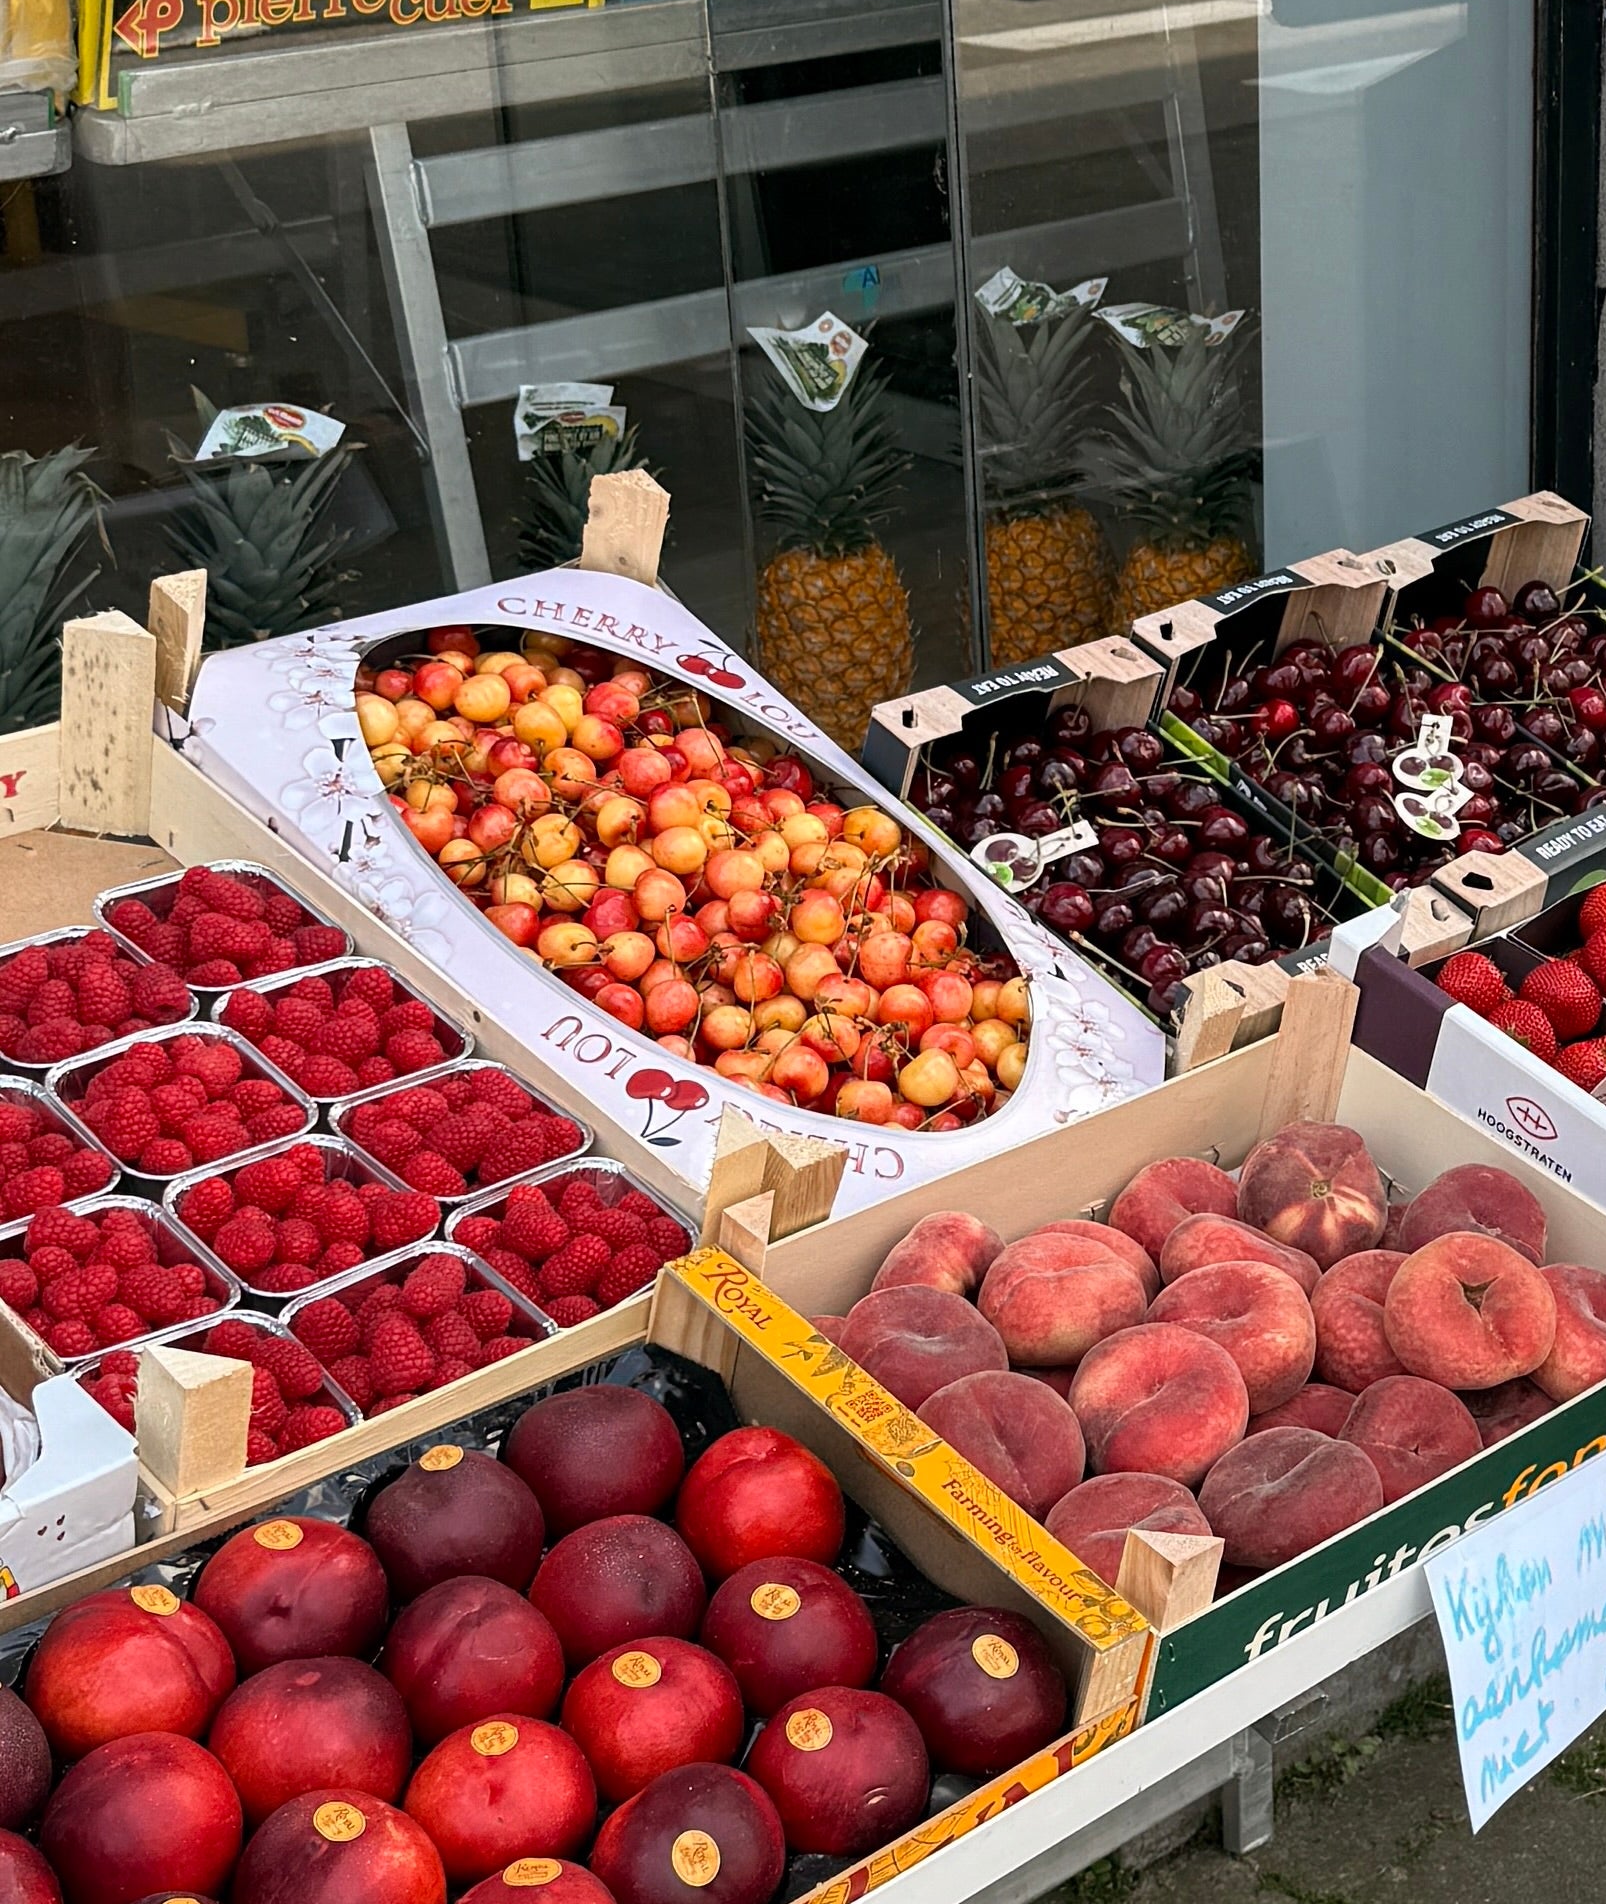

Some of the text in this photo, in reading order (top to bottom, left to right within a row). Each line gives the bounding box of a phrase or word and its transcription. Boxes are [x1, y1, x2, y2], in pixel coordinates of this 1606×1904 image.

[496, 596, 820, 741] CHERRY LOU
[971, 664, 1060, 696] READY TO EAT
[1535, 832, 1577, 860] READY
[1570, 825, 1593, 841] TO
[540, 1015, 637, 1080] LOU
[1477, 1107, 1573, 1184] HOOGSTRATEN
[941, 1478, 1015, 1546] Farming
[1020, 1550, 1085, 1604] flavour
